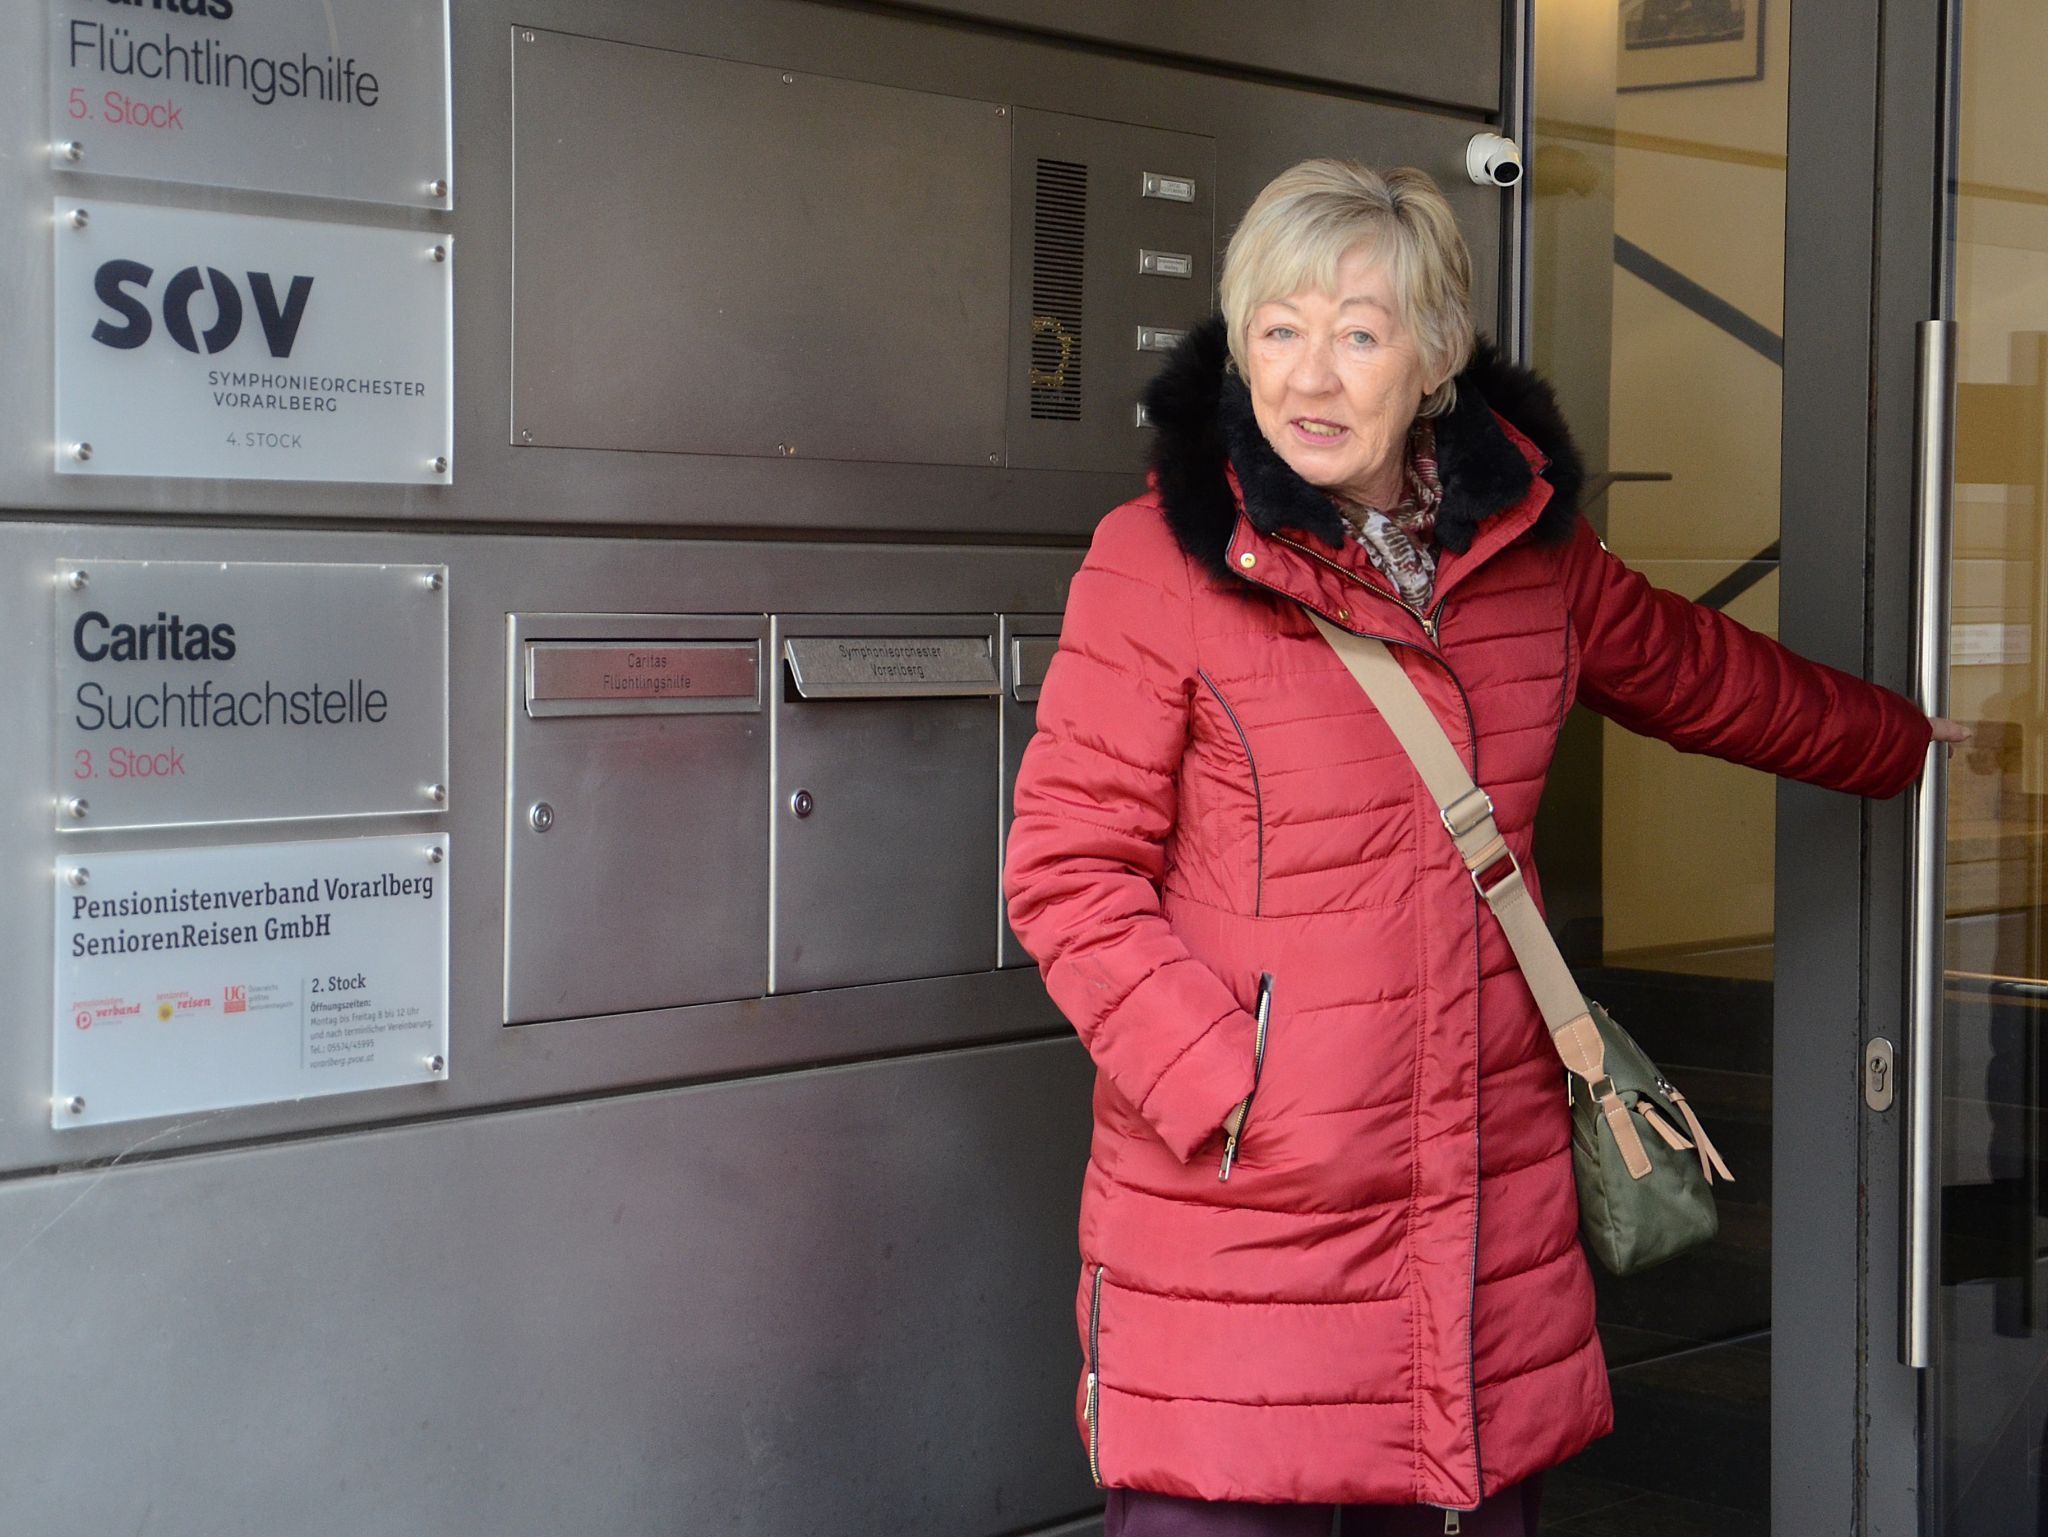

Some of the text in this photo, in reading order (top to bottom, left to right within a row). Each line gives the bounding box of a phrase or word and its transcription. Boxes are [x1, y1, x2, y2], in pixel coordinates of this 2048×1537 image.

[69, 19, 379, 107] Flüchtlingshilfe
[68, 88, 184, 130] 5. Stock
[91, 258, 315, 359] SOV
[208, 371, 426, 397] SYMPHONIEORCHESTER
[213, 392, 337, 413] VORARLBERG
[226, 432, 303, 449] 4. STOCK
[73, 611, 237, 662] Caritas
[627, 653, 668, 668] Caritas
[838, 644, 942, 661] Symphonieorchester
[871, 663, 925, 679] Vorarlberg
[75, 679, 388, 731] Suchtfachstelle
[74, 747, 186, 780] 3. Stock
[72, 873, 434, 920] Pensionistenverband Vorarlberg
[72, 913, 332, 957] SeniorenReisen GmbH
[223, 984, 247, 1001] UG
[311, 973, 367, 993] 2. Stock
[96, 1002, 141, 1018] verband
[176, 996, 212, 1009] reisen
[310, 999, 372, 1013] Öffnungszeiten:
